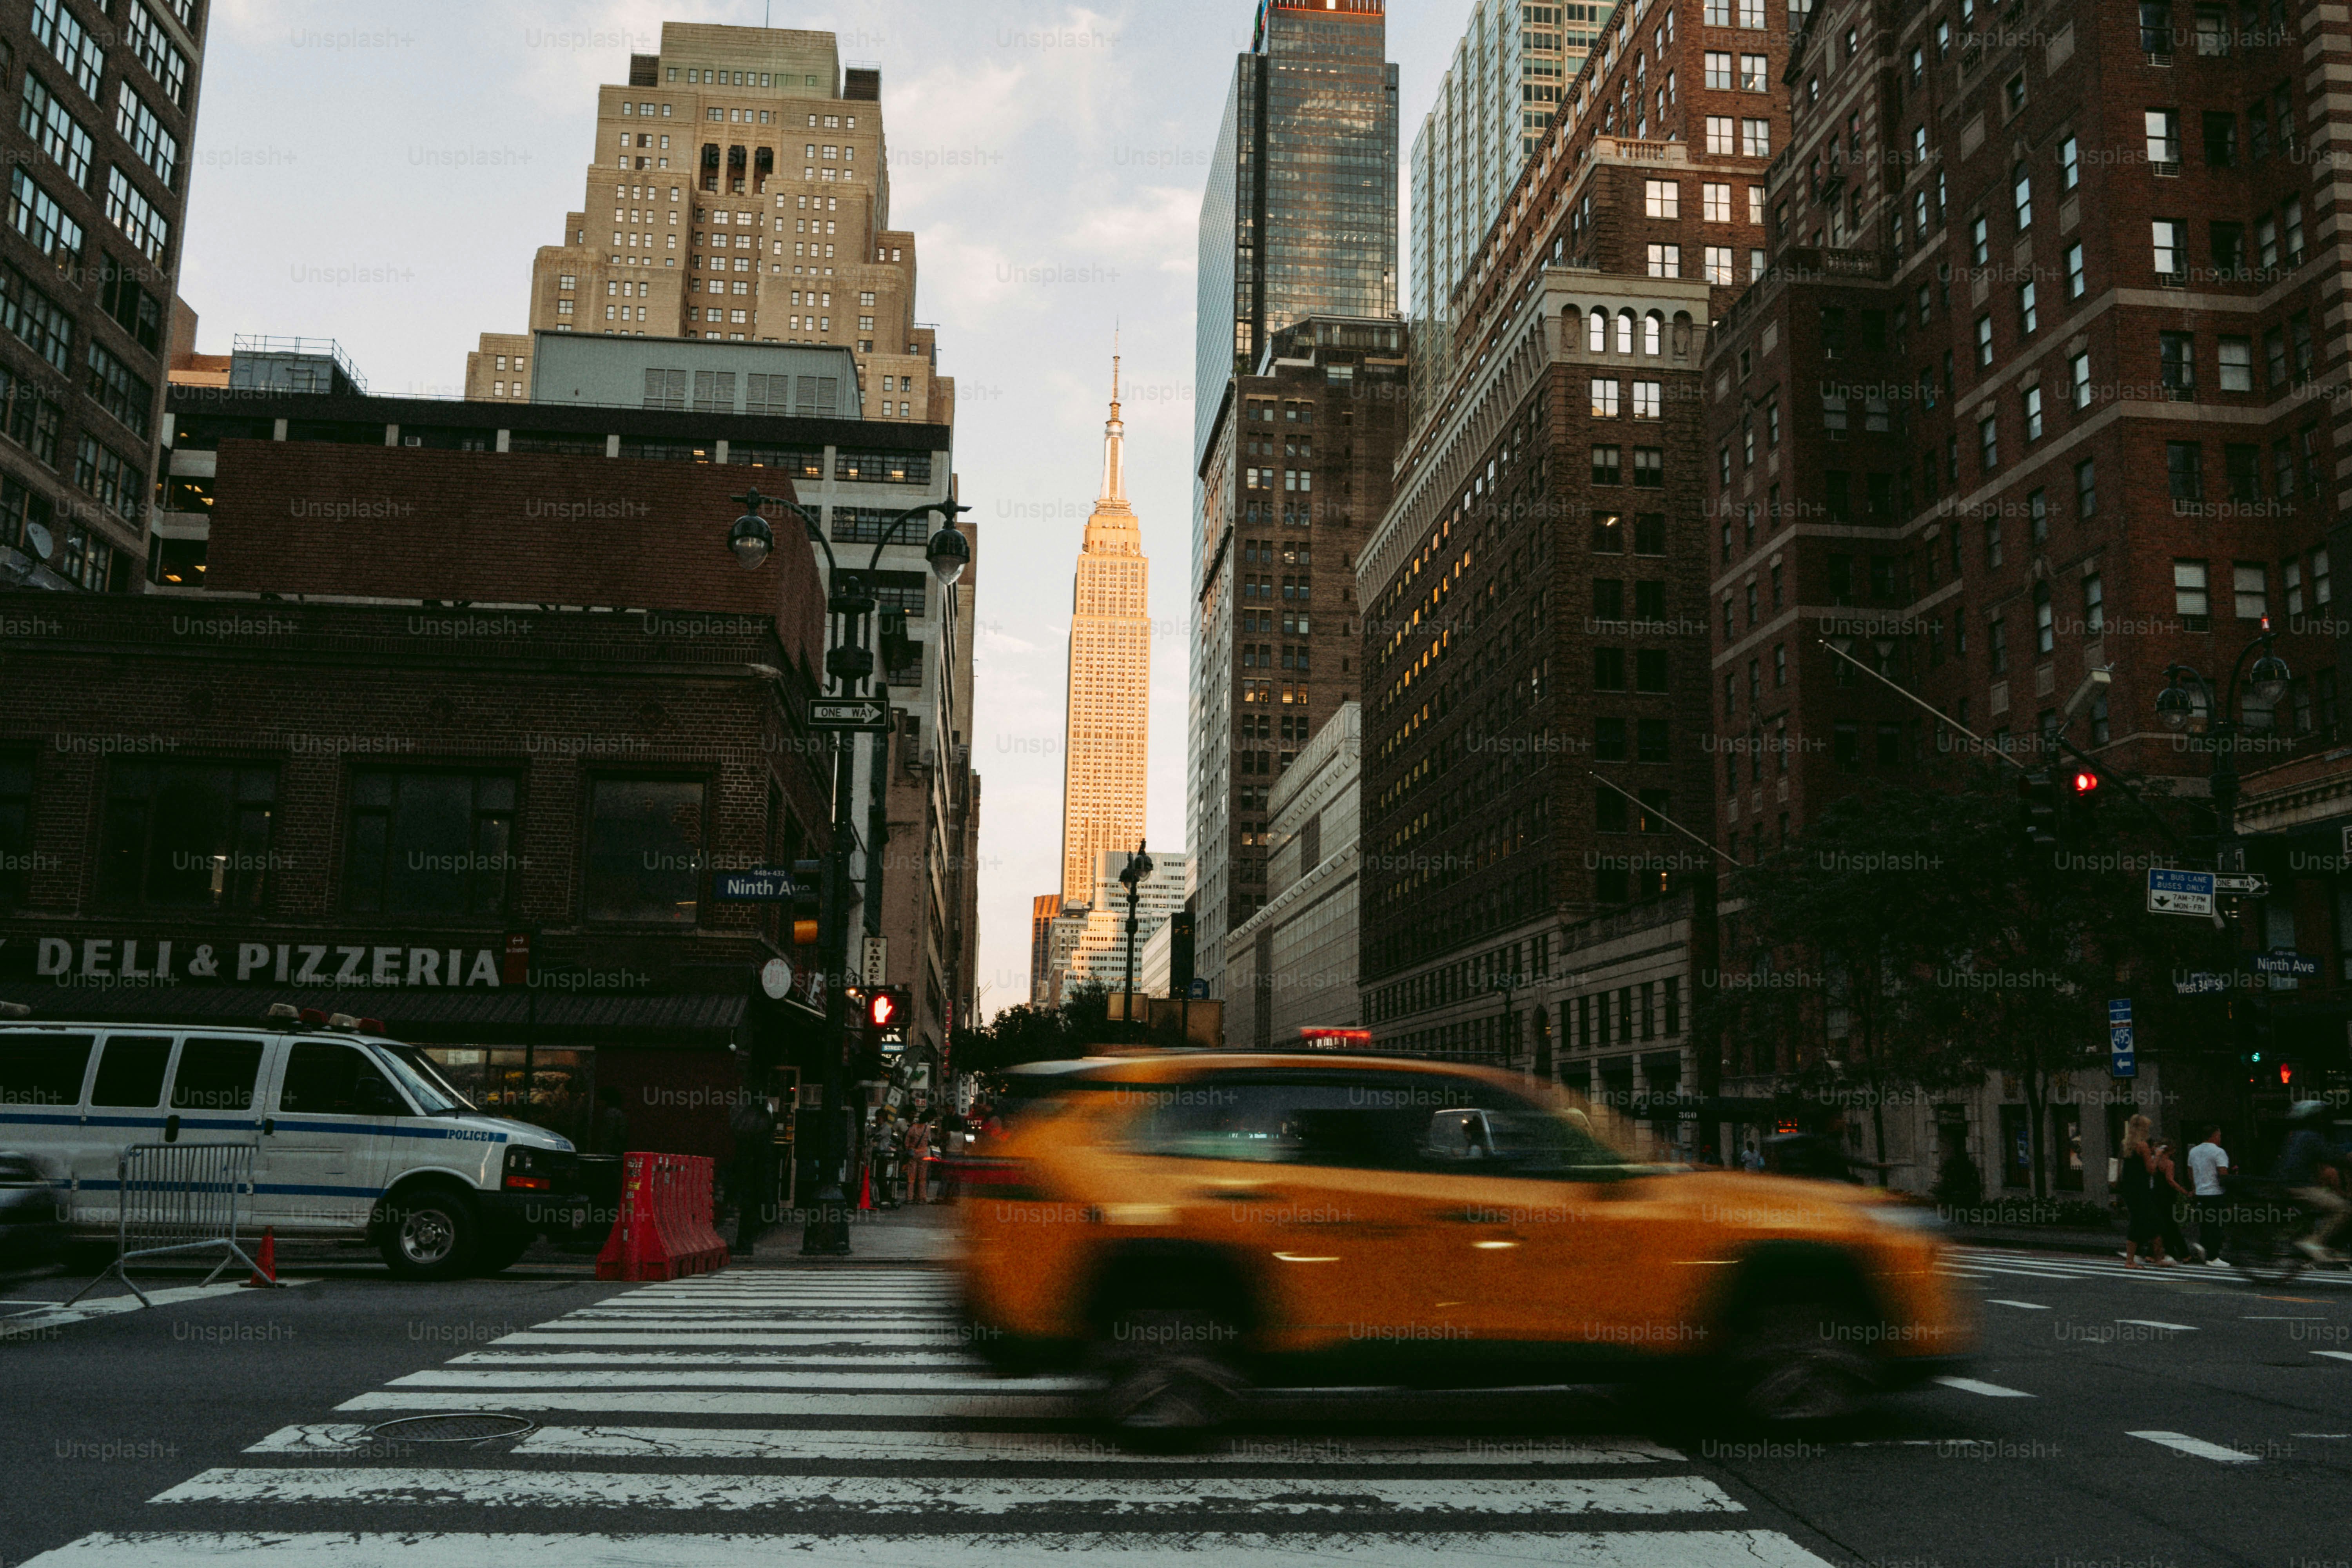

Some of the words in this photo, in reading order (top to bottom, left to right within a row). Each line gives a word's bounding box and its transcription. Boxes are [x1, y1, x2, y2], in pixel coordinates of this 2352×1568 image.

[821, 708, 842, 717] ONE
[851, 708, 874, 717] WAY
[2157, 881, 2182, 890] BUSES
[2188, 875, 2208, 884] LANE
[728, 879, 774, 895] Ninth
[36, 937, 172, 978] DELI
[188, 944, 219, 977] &
[237, 942, 500, 987] PIZZERIA
[2257, 957, 2290, 971] Ninth
[2292, 959, 2315, 973] Ave
[2176, 982, 2197, 994] West
[2215, 978, 2224, 992] St
[2113, 1029, 2131, 1045] 495
[1678, 1111, 1697, 1120] 360
[449, 1129, 486, 1141] POLICE
